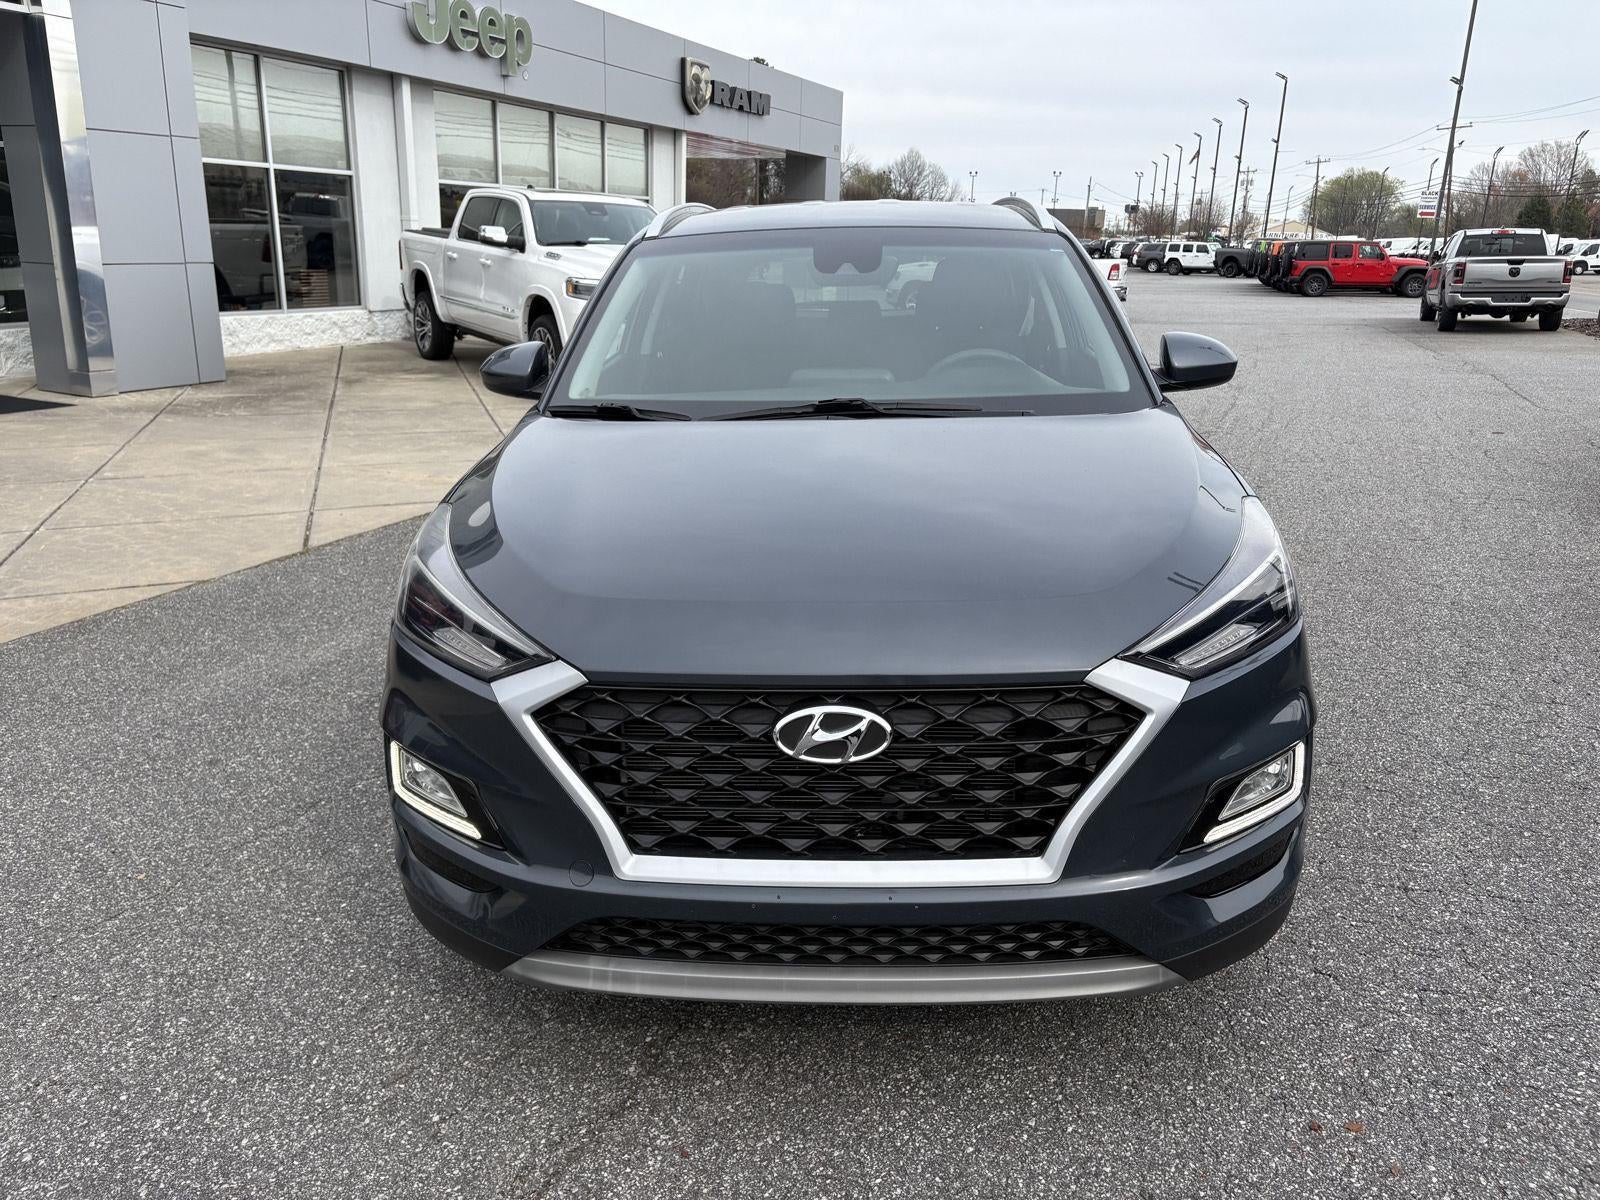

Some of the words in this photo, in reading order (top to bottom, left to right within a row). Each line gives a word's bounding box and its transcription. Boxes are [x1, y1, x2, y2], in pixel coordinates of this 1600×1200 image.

[405, 0, 532, 76] Jeep
[711, 79, 771, 116] RAM
[1260, 231, 1300, 239] FURNIURE
